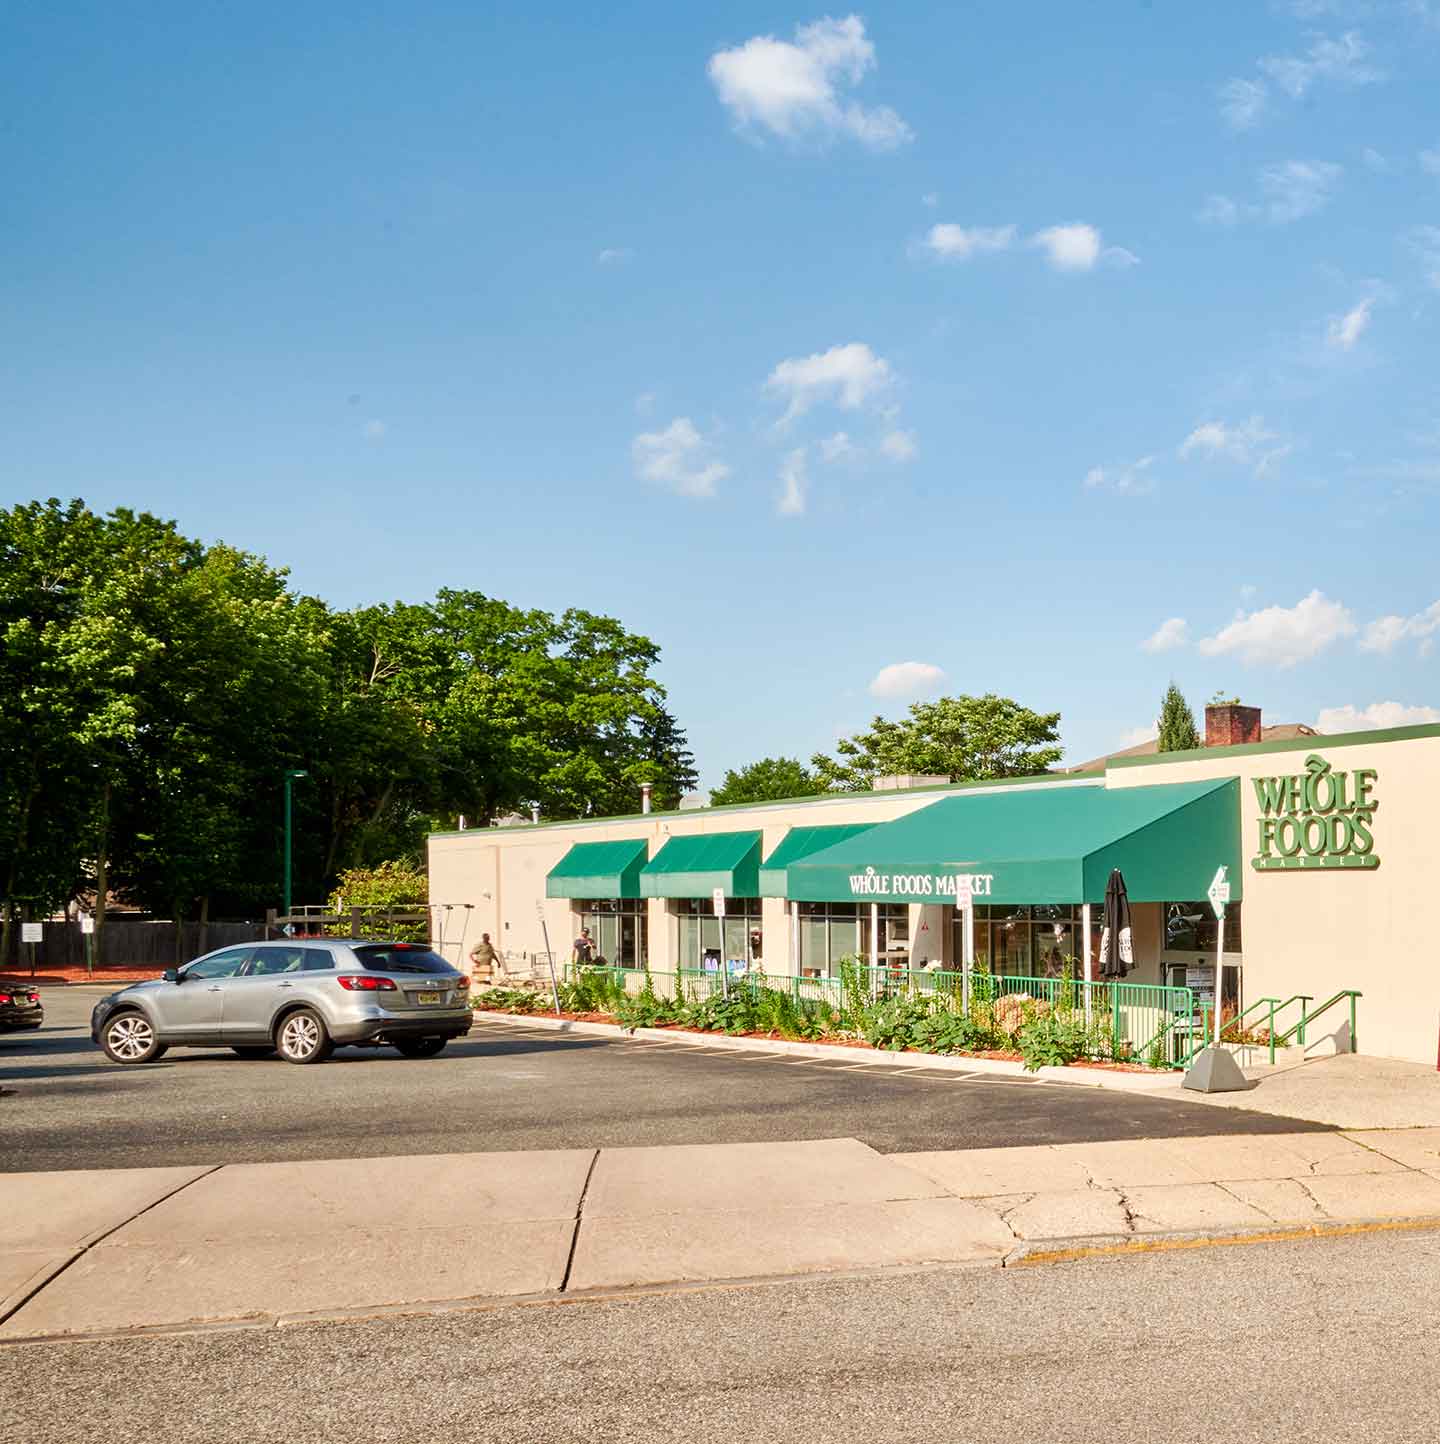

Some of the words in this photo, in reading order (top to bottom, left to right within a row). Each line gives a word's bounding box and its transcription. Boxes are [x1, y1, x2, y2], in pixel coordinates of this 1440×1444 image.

[1250, 754, 1379, 817] WHOLE
[1256, 811, 1373, 857] FOODS
[849, 866, 889, 894] WHOLE
[893, 875, 932, 895] FOODS
[935, 875, 993, 895] MAKET
[1260, 857, 1366, 867] MARKET
